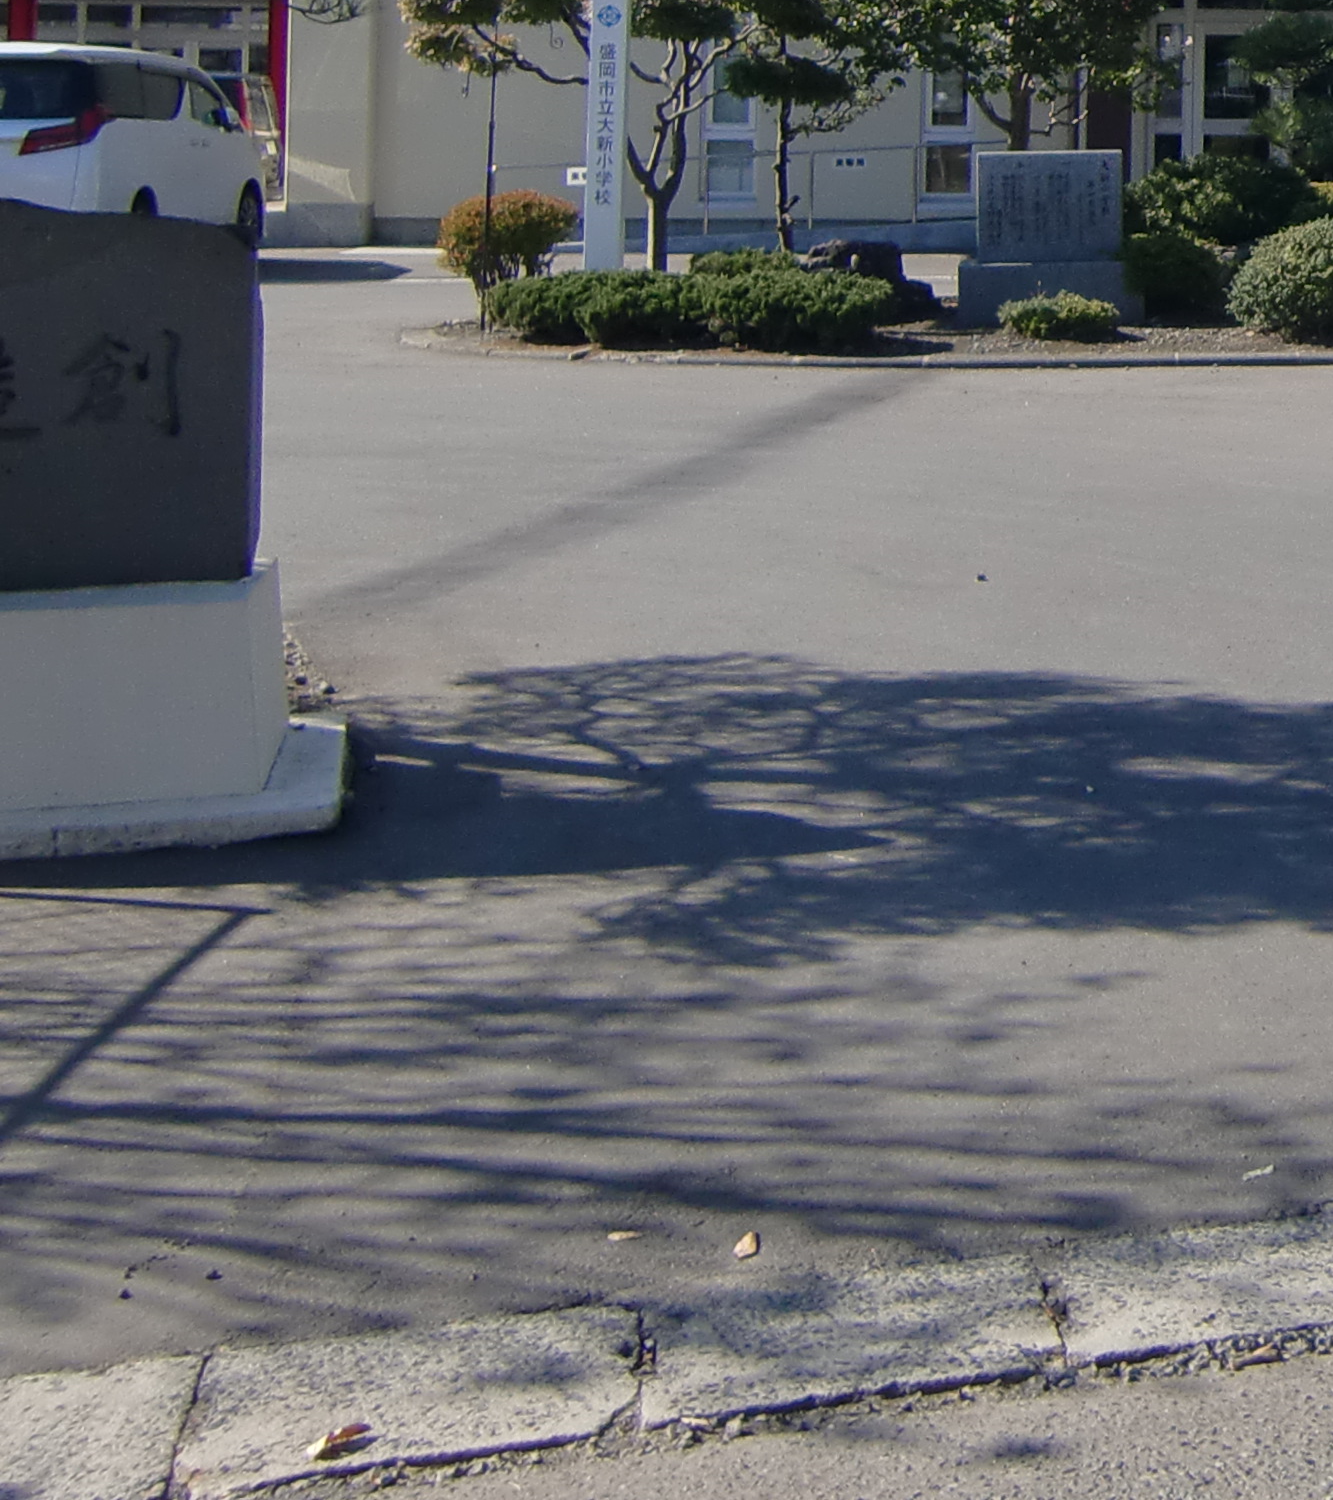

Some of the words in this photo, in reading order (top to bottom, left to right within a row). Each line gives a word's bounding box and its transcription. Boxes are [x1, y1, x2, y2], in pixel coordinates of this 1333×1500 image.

[594, 43, 616, 205] 盛岡市立大新小学校
